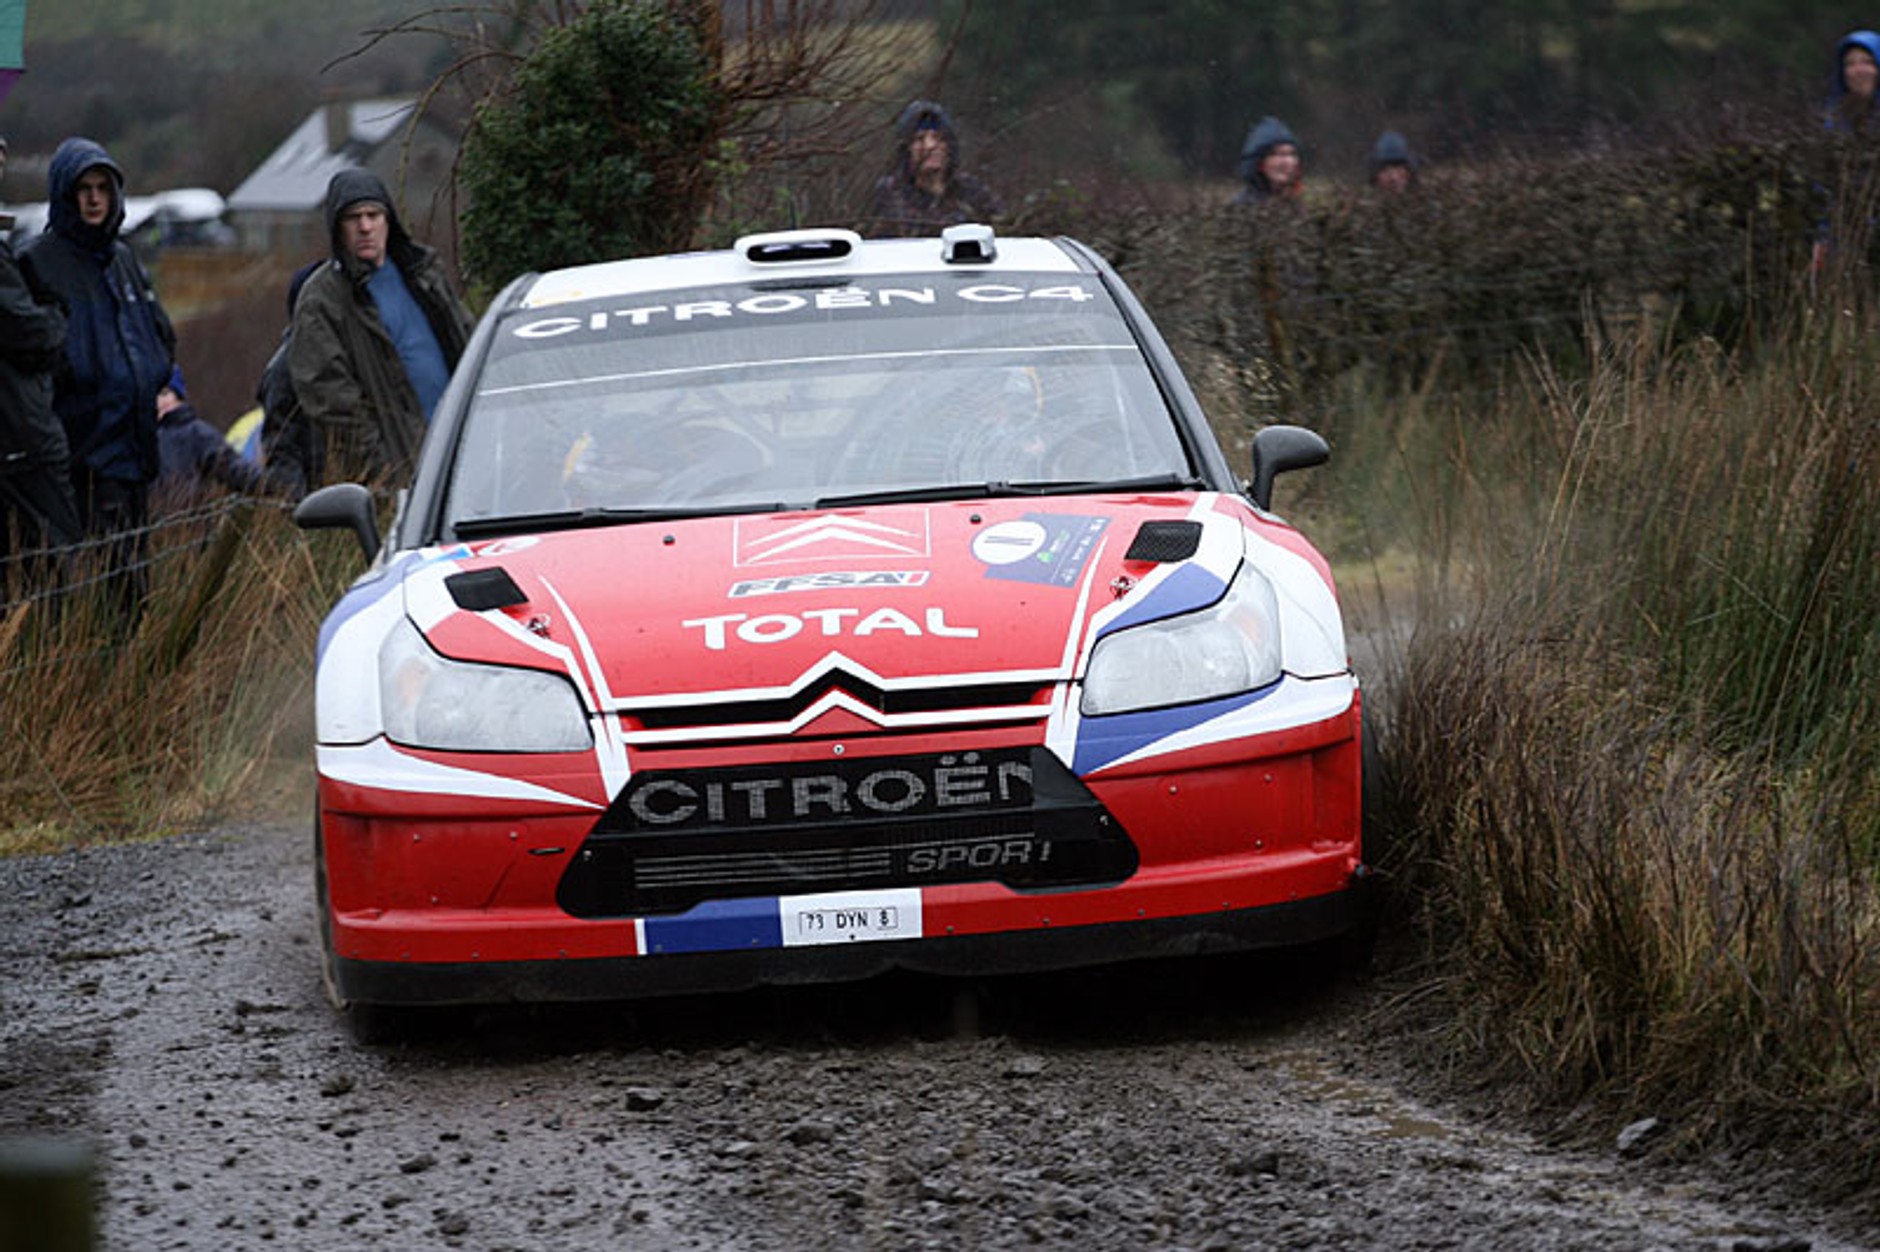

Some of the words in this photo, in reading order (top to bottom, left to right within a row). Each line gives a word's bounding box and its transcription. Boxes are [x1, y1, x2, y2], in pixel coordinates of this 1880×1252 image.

[513, 286, 936, 338] CITROËN
[956, 284, 1095, 303] C4
[732, 571, 904, 596] FFSA
[682, 607, 979, 650] TOTAL
[836, 911, 868, 929] DYN
